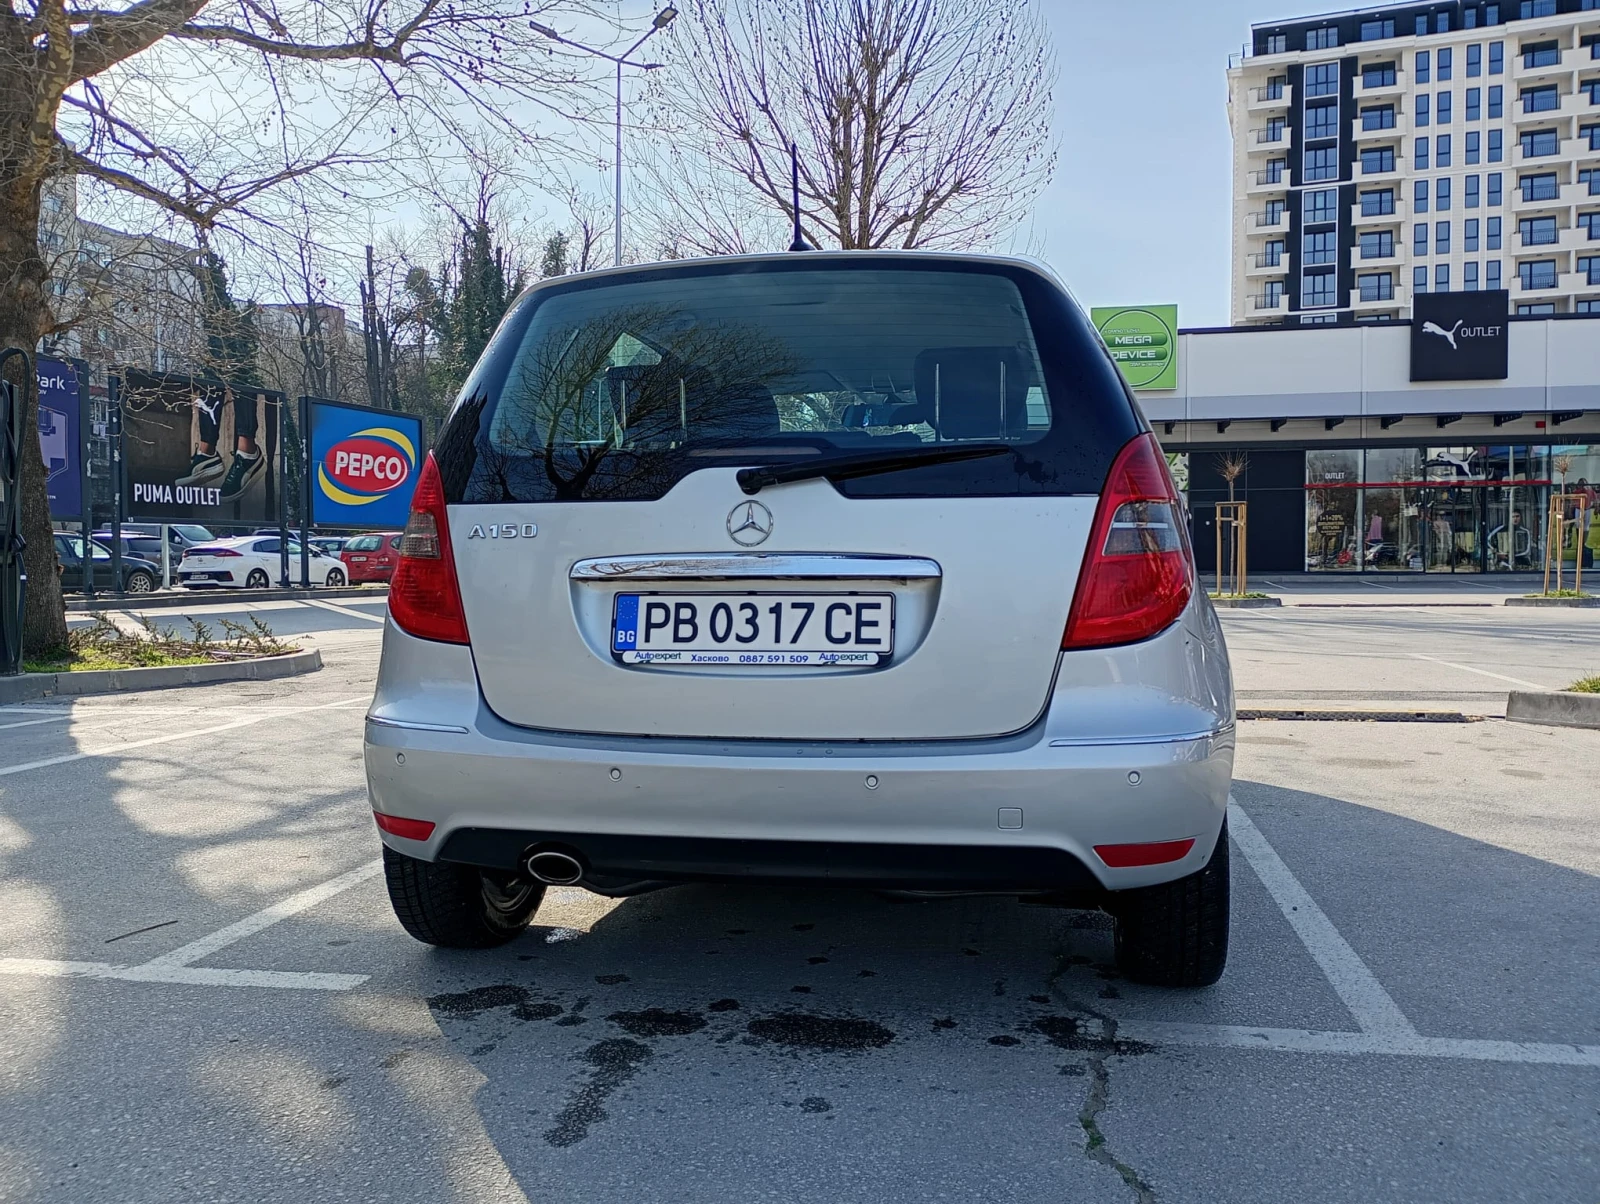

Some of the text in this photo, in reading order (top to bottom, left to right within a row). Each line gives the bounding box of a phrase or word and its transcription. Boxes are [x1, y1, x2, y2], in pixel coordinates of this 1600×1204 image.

[1461, 326, 1501, 337] OUTLET
[1115, 335, 1152, 344] MEGA
[1111, 350, 1156, 360] DEVICE
[335, 450, 402, 480] PEPCO
[134, 483, 221, 506] PUMA OUTLET
[644, 602, 882, 645] PB 0317 CE
[617, 631, 635, 643] BG
[634, 652, 868, 663] Autoexpert Хасково 0887 591 509 Autoexpert
